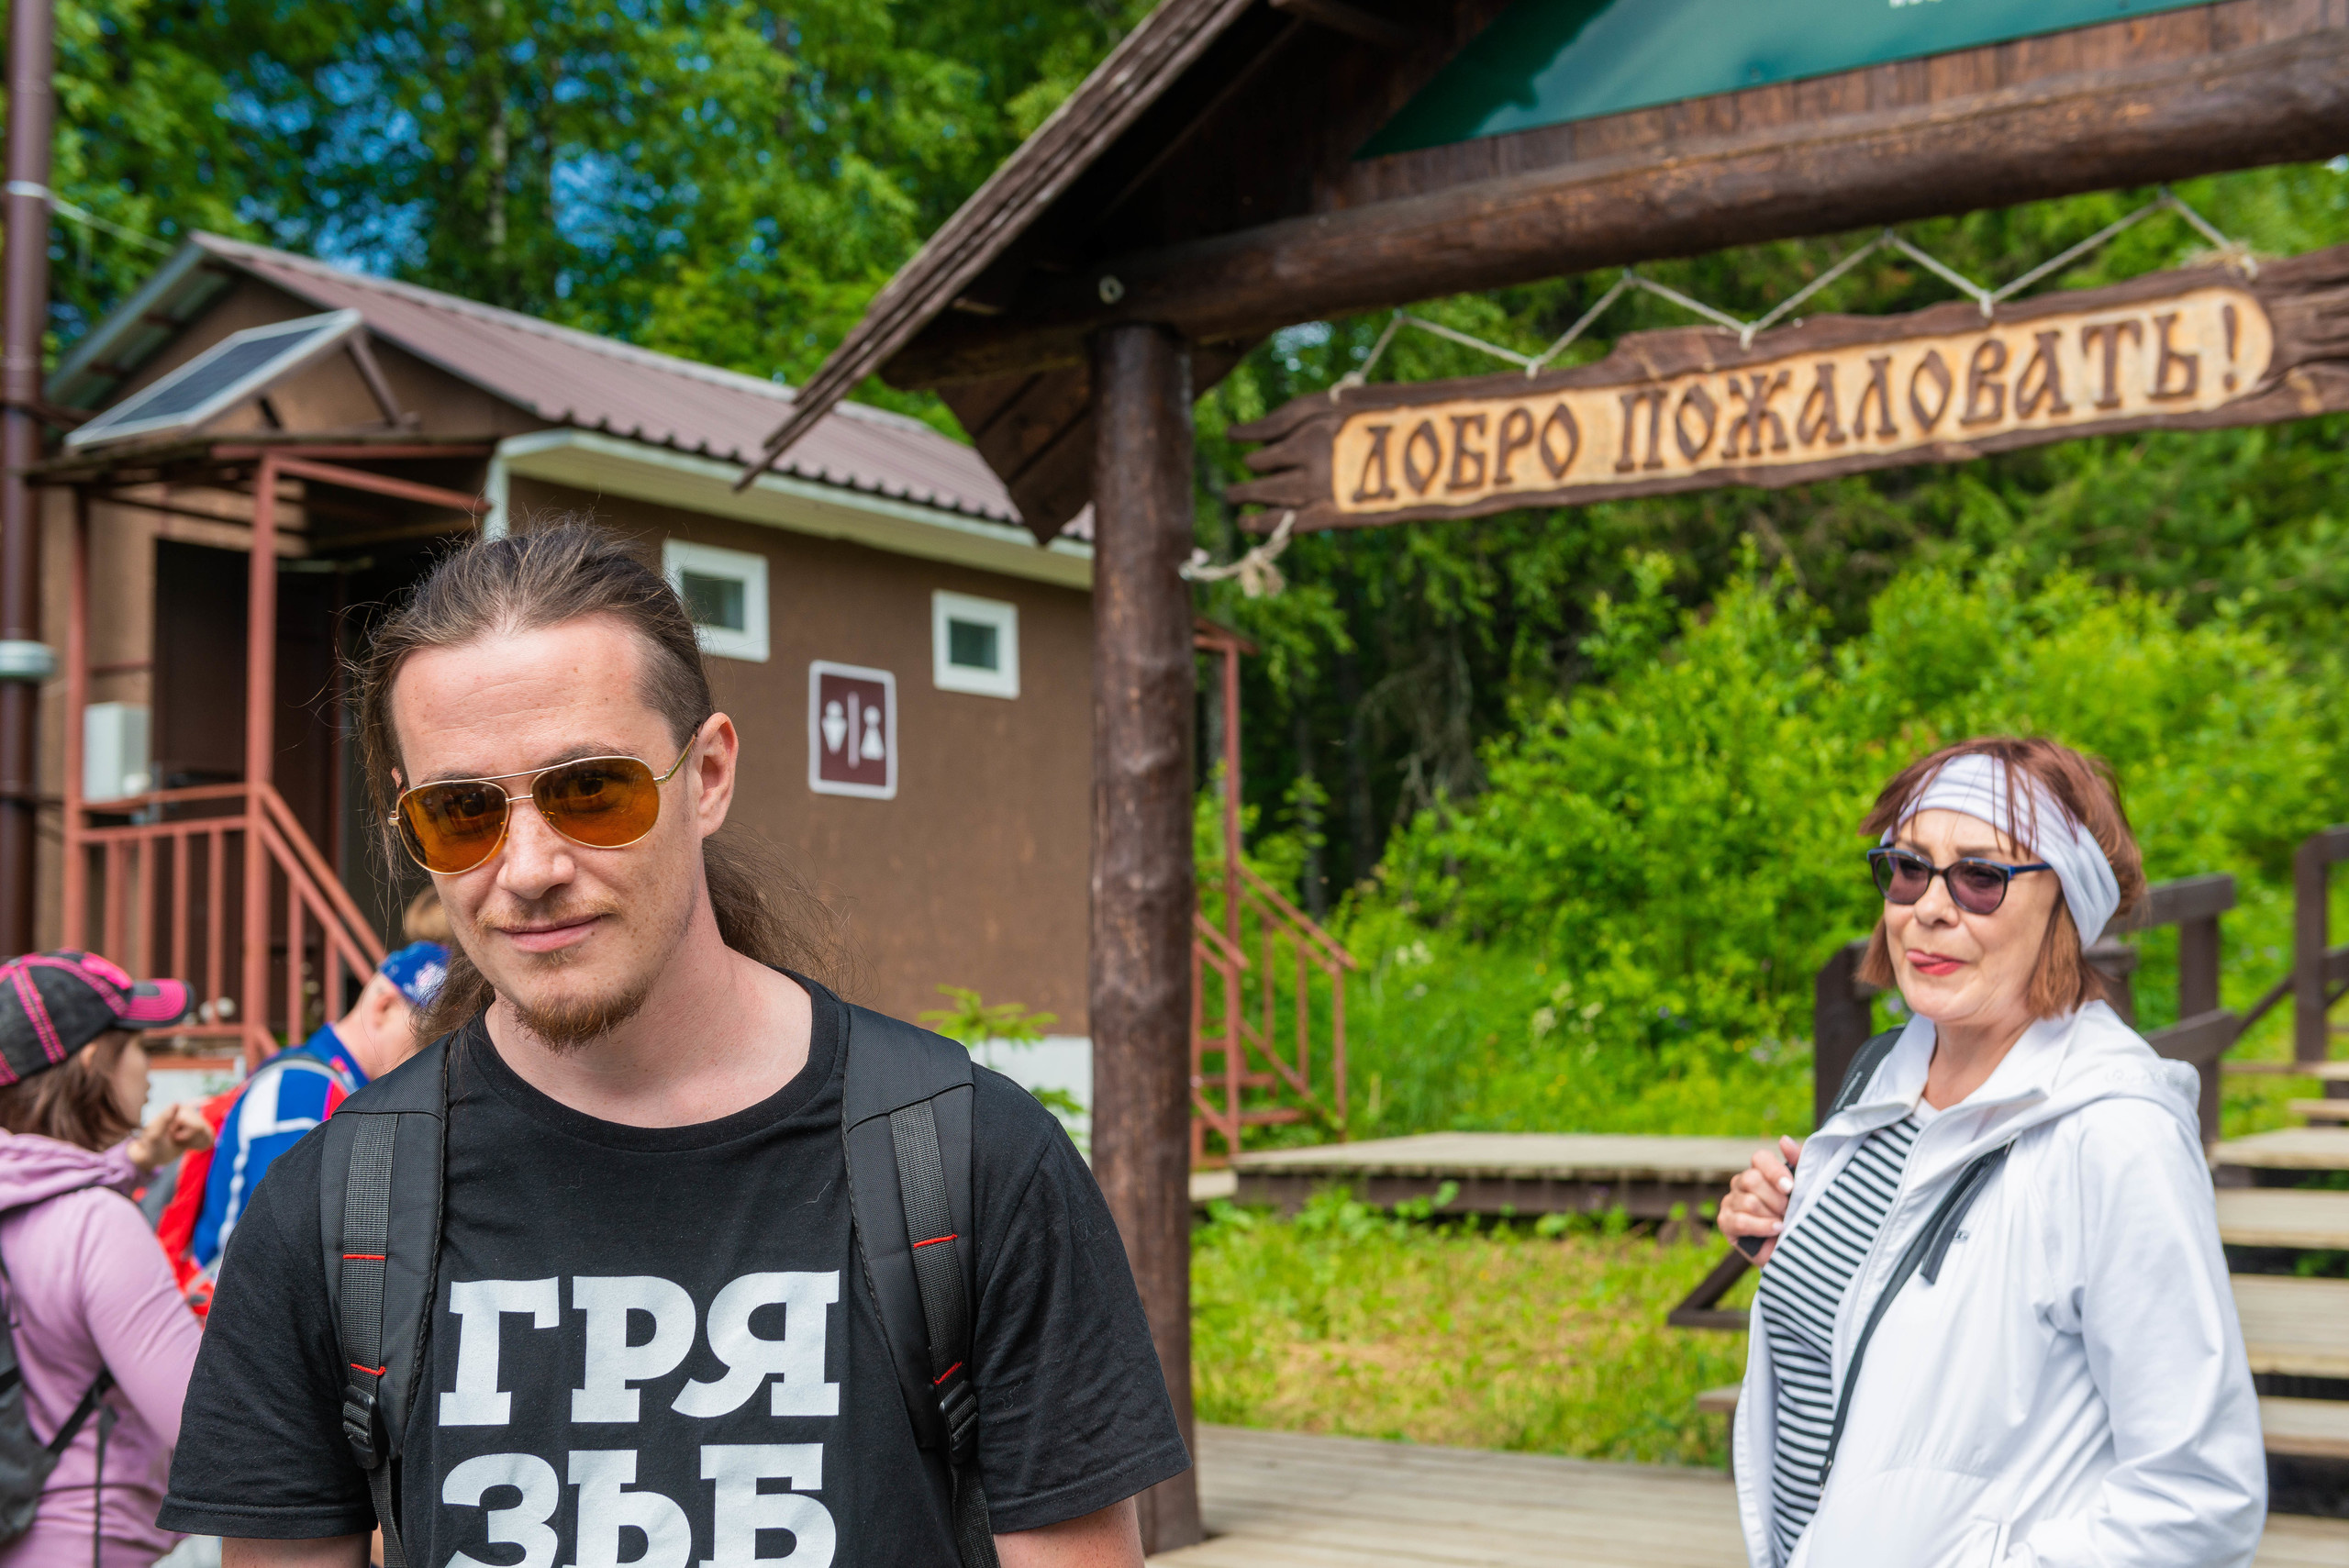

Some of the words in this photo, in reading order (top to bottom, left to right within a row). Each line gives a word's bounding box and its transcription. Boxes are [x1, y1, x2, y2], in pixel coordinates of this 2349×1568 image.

[1352, 402, 1580, 504] ДОБРО
[1614, 304, 2240, 474] ПОЖАЛОВАТЬ!
[439, 1270, 841, 1426] ГРЯ
[441, 1443, 837, 1568] ЗЬБ
